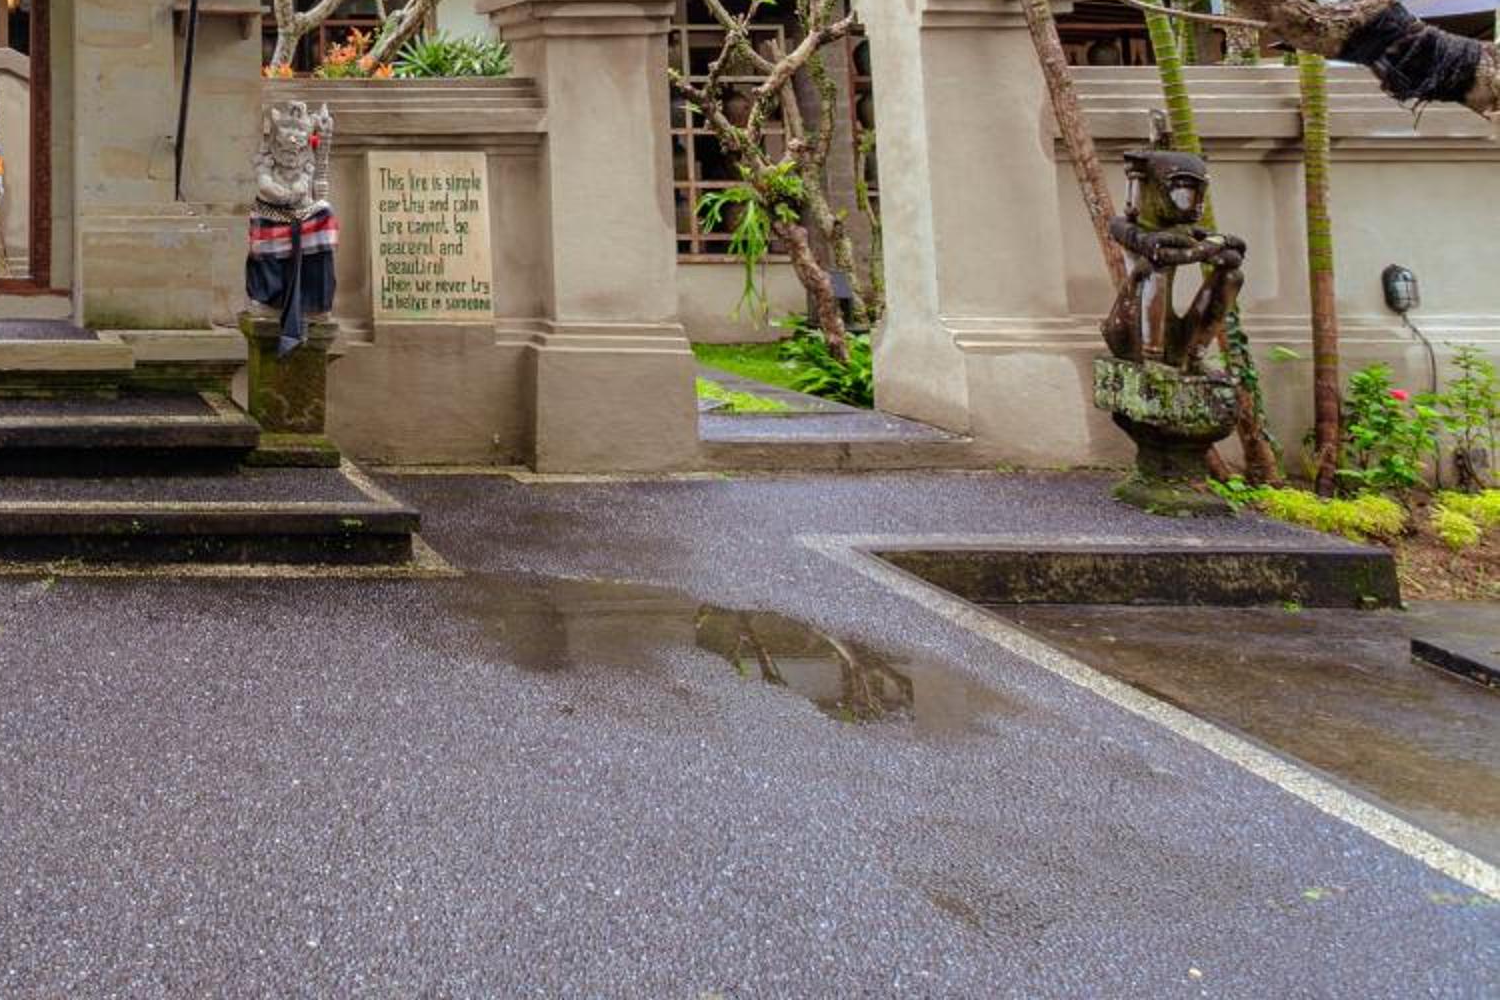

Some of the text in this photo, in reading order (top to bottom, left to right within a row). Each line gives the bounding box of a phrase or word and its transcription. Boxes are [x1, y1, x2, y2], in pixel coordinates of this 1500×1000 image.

[379, 167, 404, 191] This
[432, 175, 442, 190] is
[445, 168, 482, 193] simple
[429, 193, 449, 212] and
[453, 191, 479, 212] calm
[454, 213, 469, 234] be
[380, 234, 463, 256] peaceful and
[385, 256, 445, 275] beautiful
[381, 275, 490, 295] When we never try
[445, 297, 491, 311] someone
